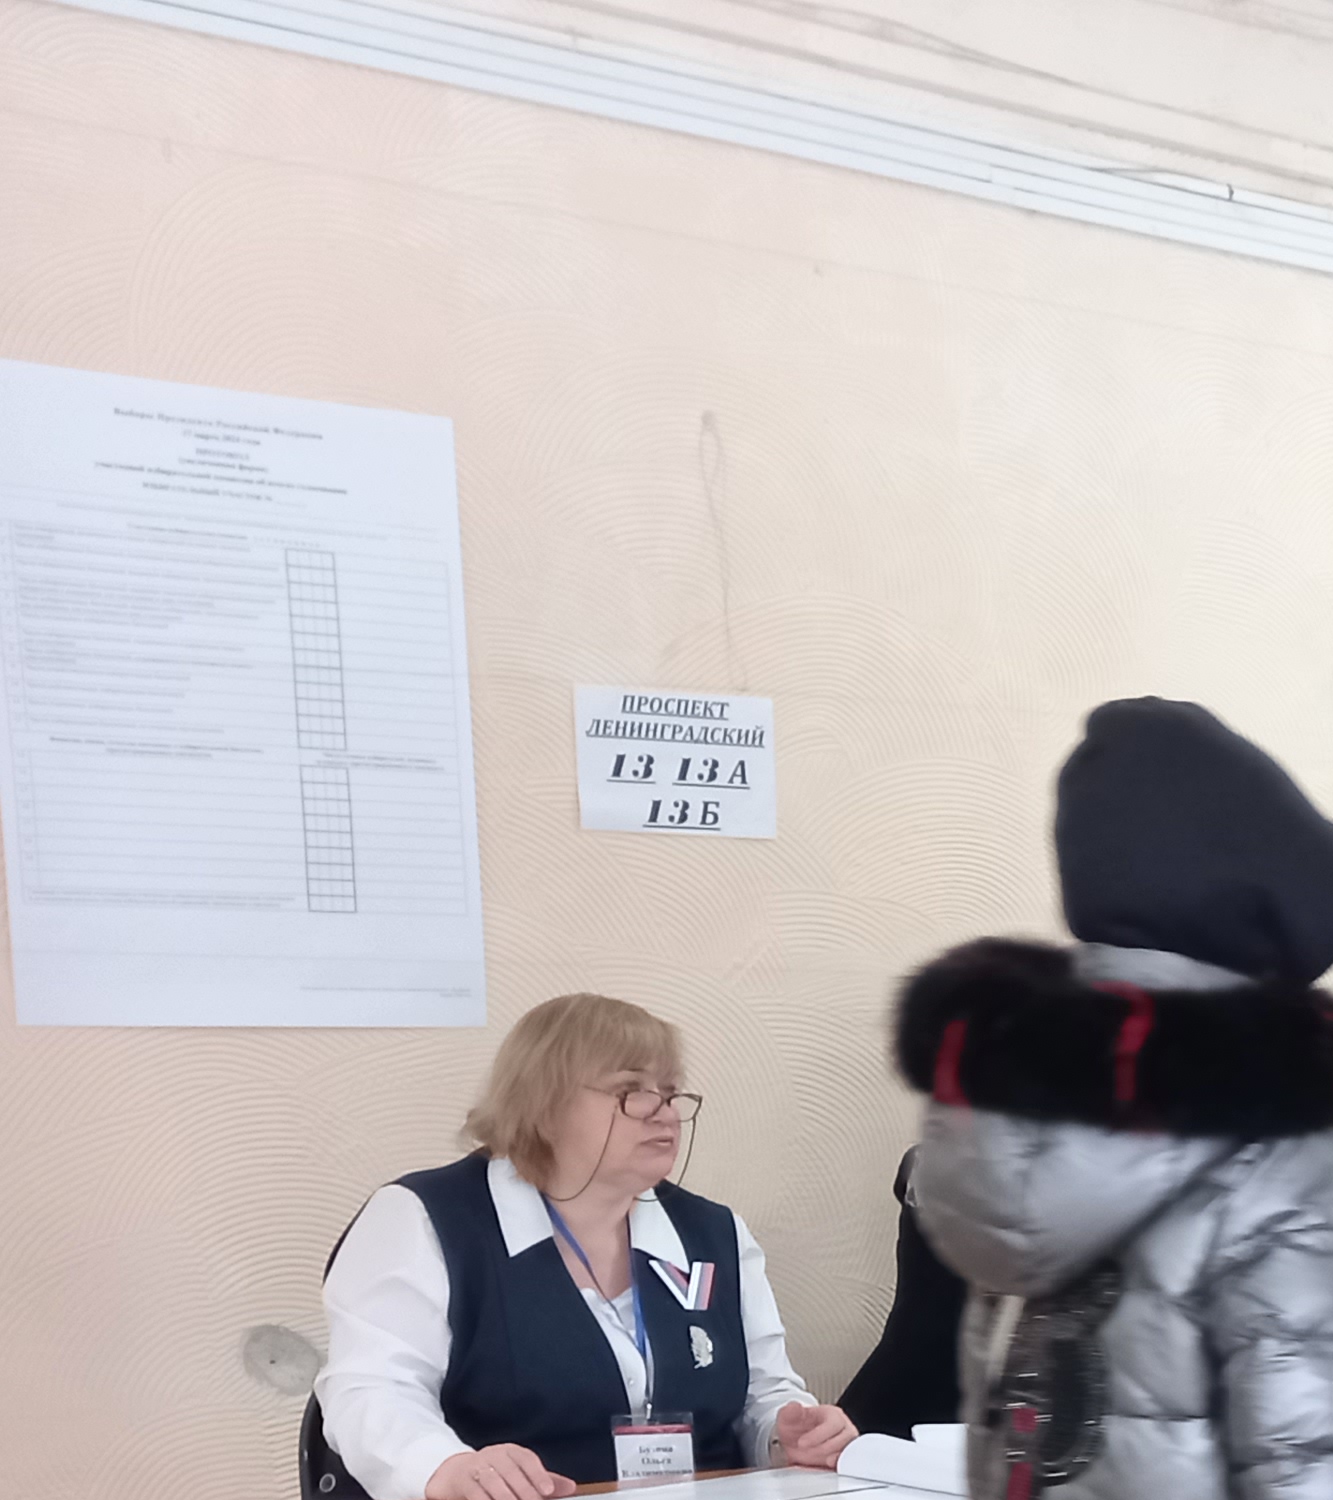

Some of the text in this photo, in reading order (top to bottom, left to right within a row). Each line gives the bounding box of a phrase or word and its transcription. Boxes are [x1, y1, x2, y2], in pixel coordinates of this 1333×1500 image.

[620, 694, 730, 720] ПРОСПЕКТ
[584, 718, 766, 748] ЛЕНИНГРАДСКИЙ
[610, 753, 656, 780] 13
